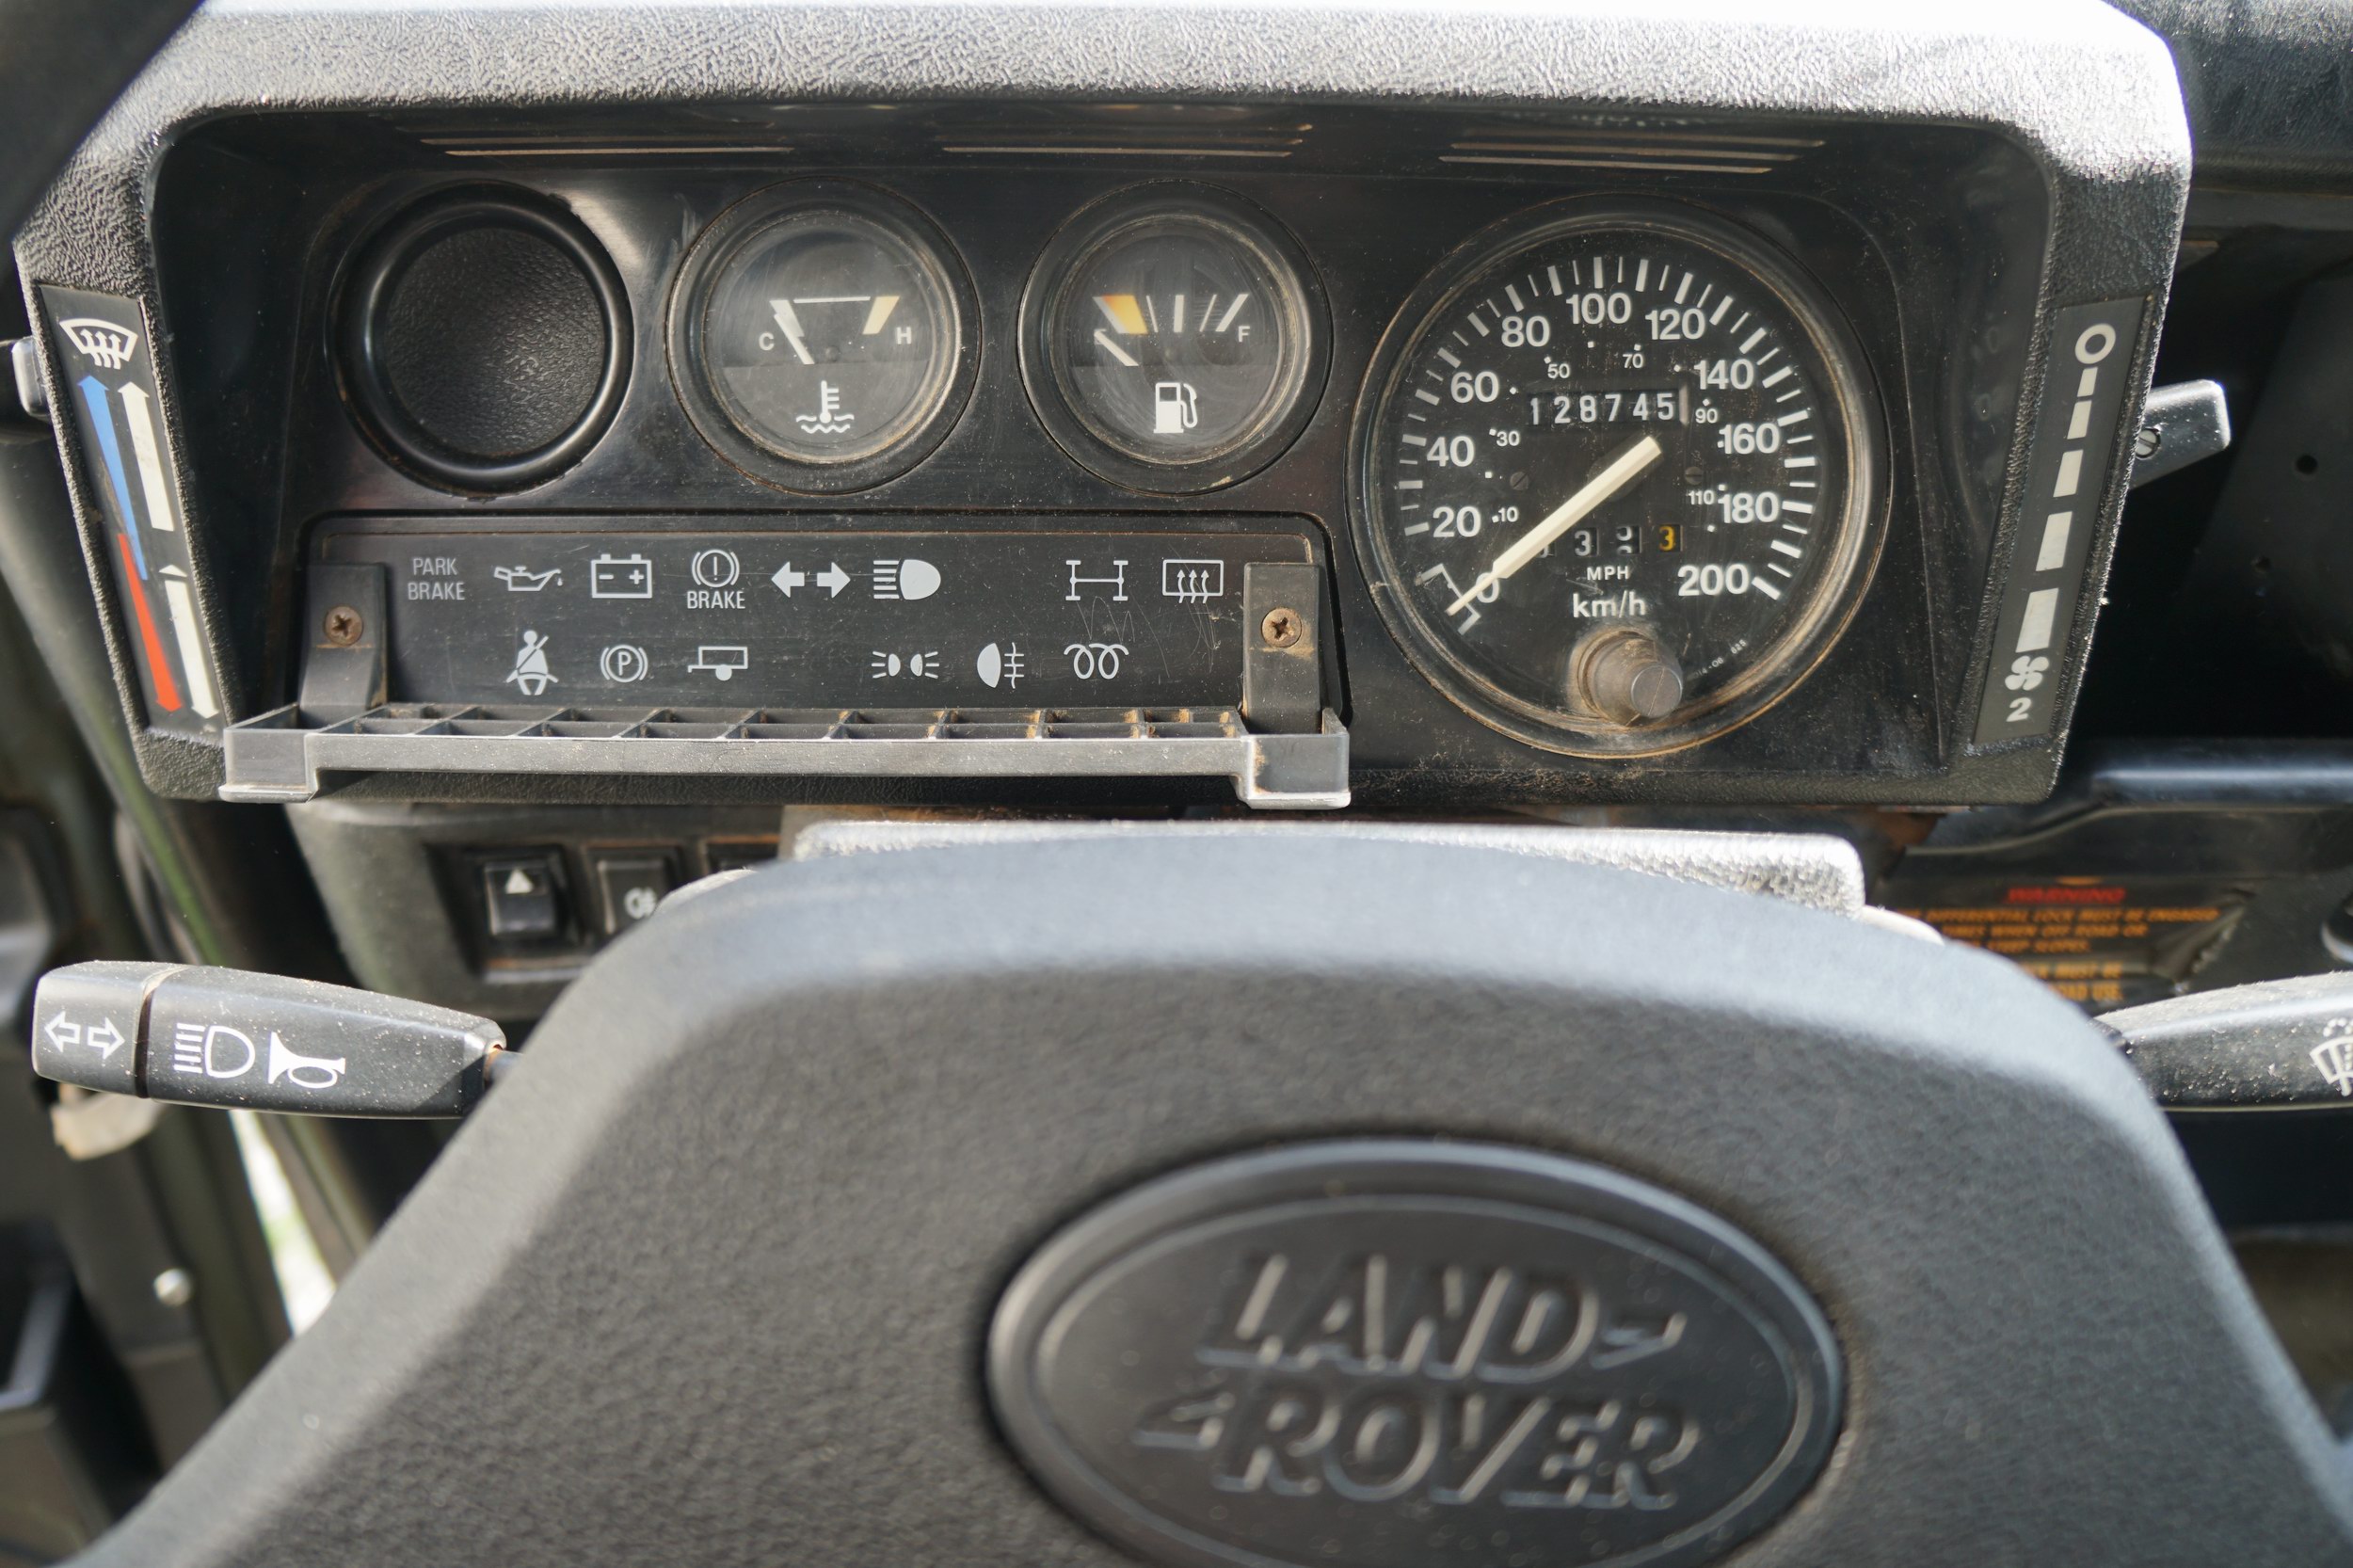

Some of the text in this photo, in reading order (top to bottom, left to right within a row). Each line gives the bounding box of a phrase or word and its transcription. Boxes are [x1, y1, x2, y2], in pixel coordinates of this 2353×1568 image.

[1565, 292, 1632, 325] 100
[895, 326, 913, 345] H
[1236, 325, 1250, 344] F
[1500, 315, 1551, 347] 80
[1644, 308, 1705, 341] 120
[758, 331, 775, 352] C
[1546, 363, 1571, 379] 50
[1622, 353, 1645, 369] 70
[1693, 359, 1754, 390] 140
[1450, 371, 1499, 403] 60
[1529, 392, 1674, 425] 128745
[1695, 408, 1719, 424] 90
[1426, 435, 1475, 467] 40
[1496, 430, 1521, 447] 30
[1719, 423, 1780, 455] 160
[1688, 489, 1715, 505] 110
[1718, 491, 1779, 523] 180
[1433, 505, 1481, 537] 20
[1497, 506, 1519, 522] 10
[412, 556, 458, 577] PARK
[1586, 566, 1630, 581] MPH
[1677, 563, 1750, 597] 200
[407, 581, 466, 602] BRAKE
[686, 589, 746, 611] BRAKE
[1475, 571, 1500, 604] 0
[1572, 589, 1647, 618] km/h
[2006, 696, 2033, 723] 2
[2006, 887, 2126, 904] WARNING
[1195, 1251, 1600, 1384] LAND
[1211, 1388, 1700, 1512] ROVER
